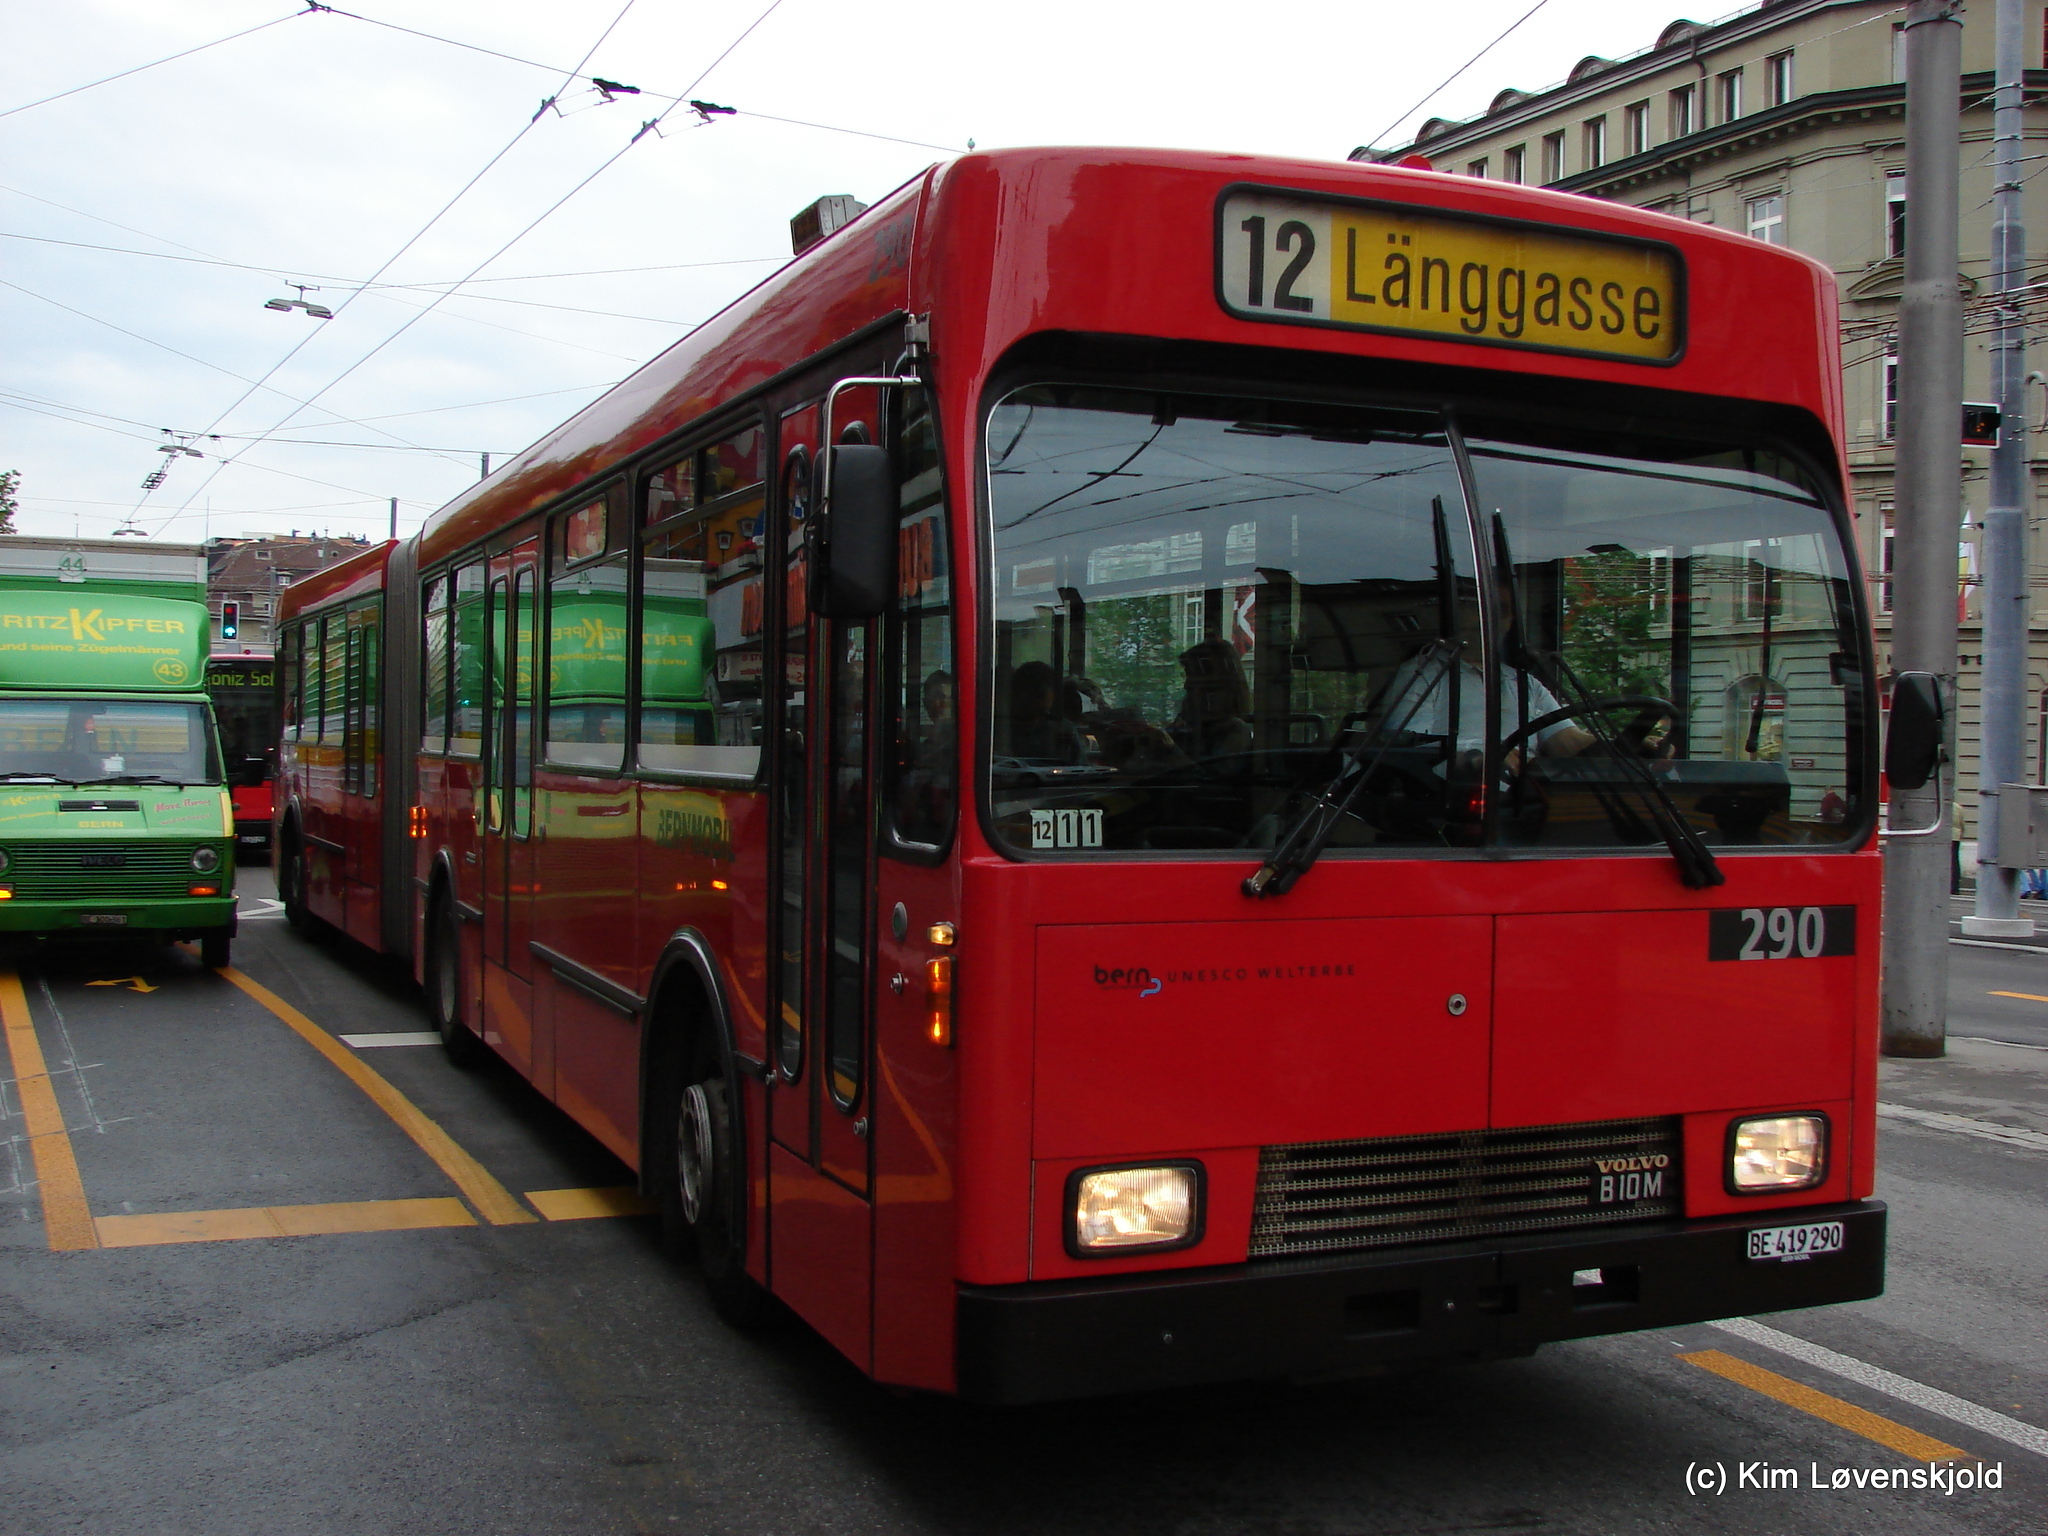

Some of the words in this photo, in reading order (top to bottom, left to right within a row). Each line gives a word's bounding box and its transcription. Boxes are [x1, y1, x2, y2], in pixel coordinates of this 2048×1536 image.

[1241, 215, 1316, 314] 12
[1346, 227, 1661, 340] Länggasse
[61, 557, 84, 571] 44
[157, 663, 183, 678] 43
[78, 820, 125, 829] BERN
[1033, 820, 1052, 840] 12
[1739, 906, 1825, 961] 290
[1094, 964, 1150, 984] bern
[1167, 968, 1248, 984] UNESCO
[1257, 964, 1356, 980] WELTERBE
[1595, 1154, 1669, 1174] VOLVO
[1600, 1171, 1662, 1203] B10M
